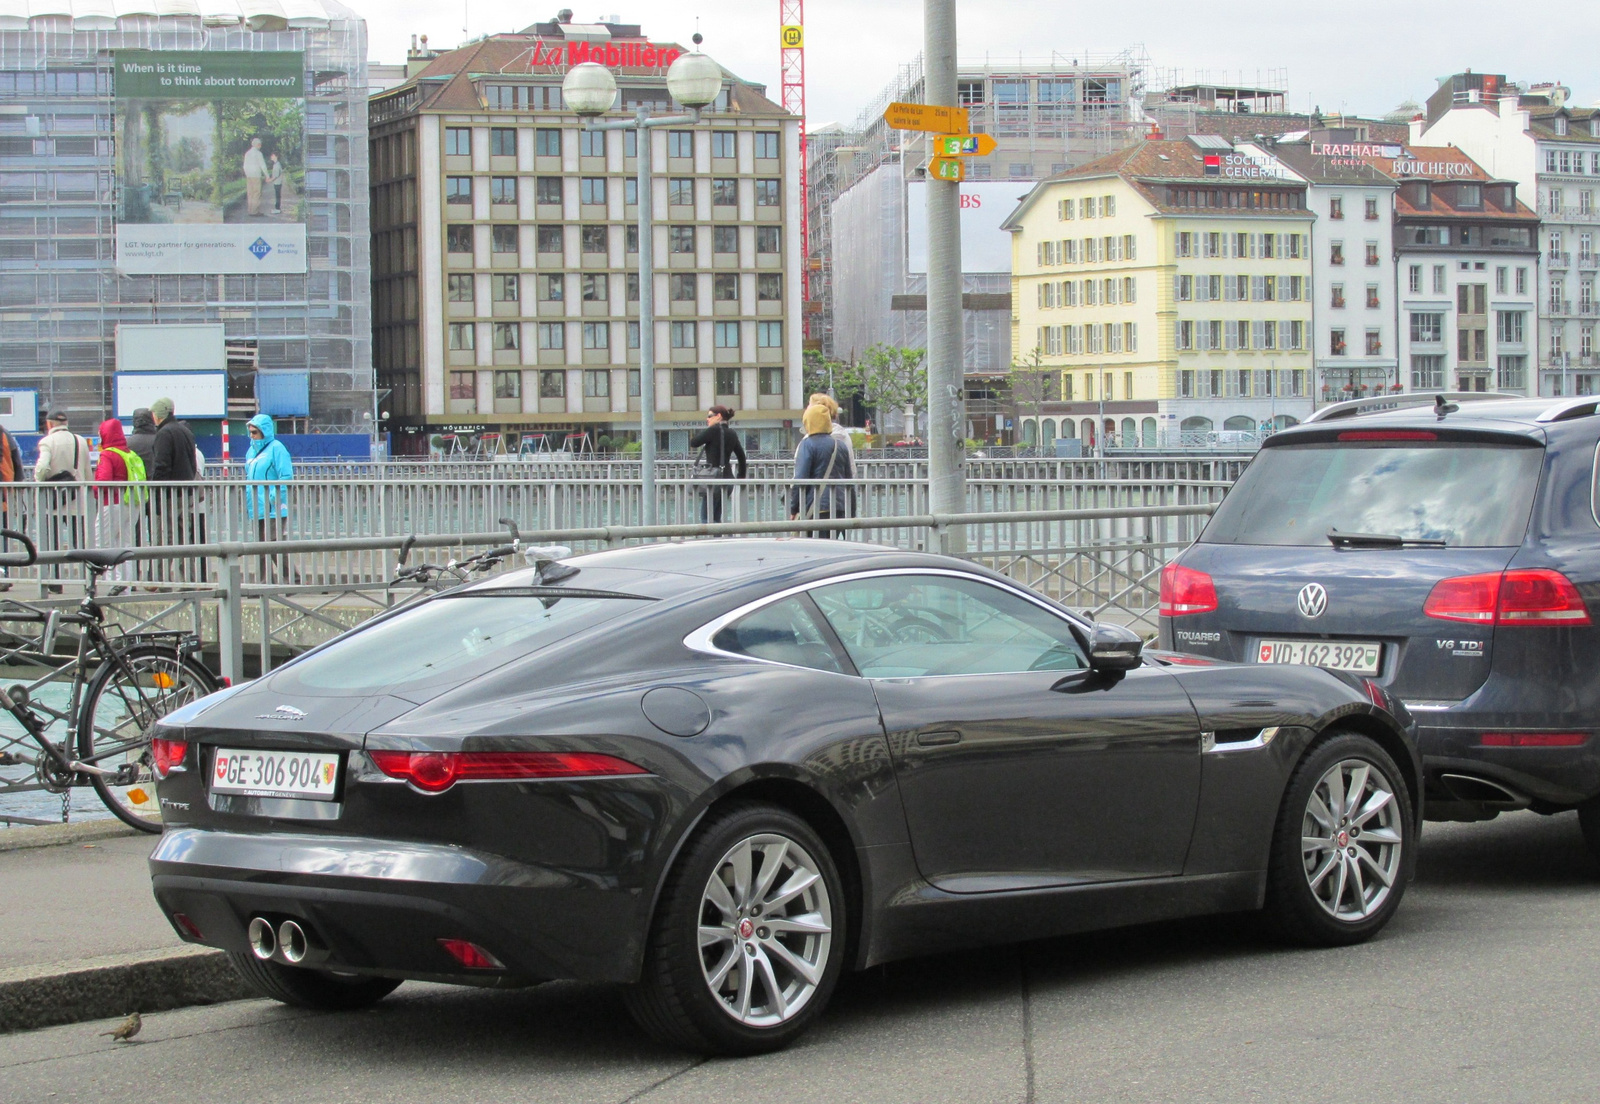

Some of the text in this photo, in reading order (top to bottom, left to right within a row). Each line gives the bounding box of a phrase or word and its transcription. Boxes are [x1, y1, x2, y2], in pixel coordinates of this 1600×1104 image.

[531, 40, 680, 67] La Mobilière
[123, 63, 202, 73] When is it time
[160, 76, 296, 86] to think about tomorrow?
[950, 139, 970, 154] 3 4
[940, 164, 958, 178] 4 3
[1392, 160, 1473, 176] BOUCHERON
[960, 194, 981, 208] BS
[158, 242, 182, 250] partner
[195, 242, 236, 250] generations.
[252, 245, 268, 253] LGT
[1177, 631, 1220, 641] TOUAREG
[1436, 640, 1484, 650] V6 TDI
